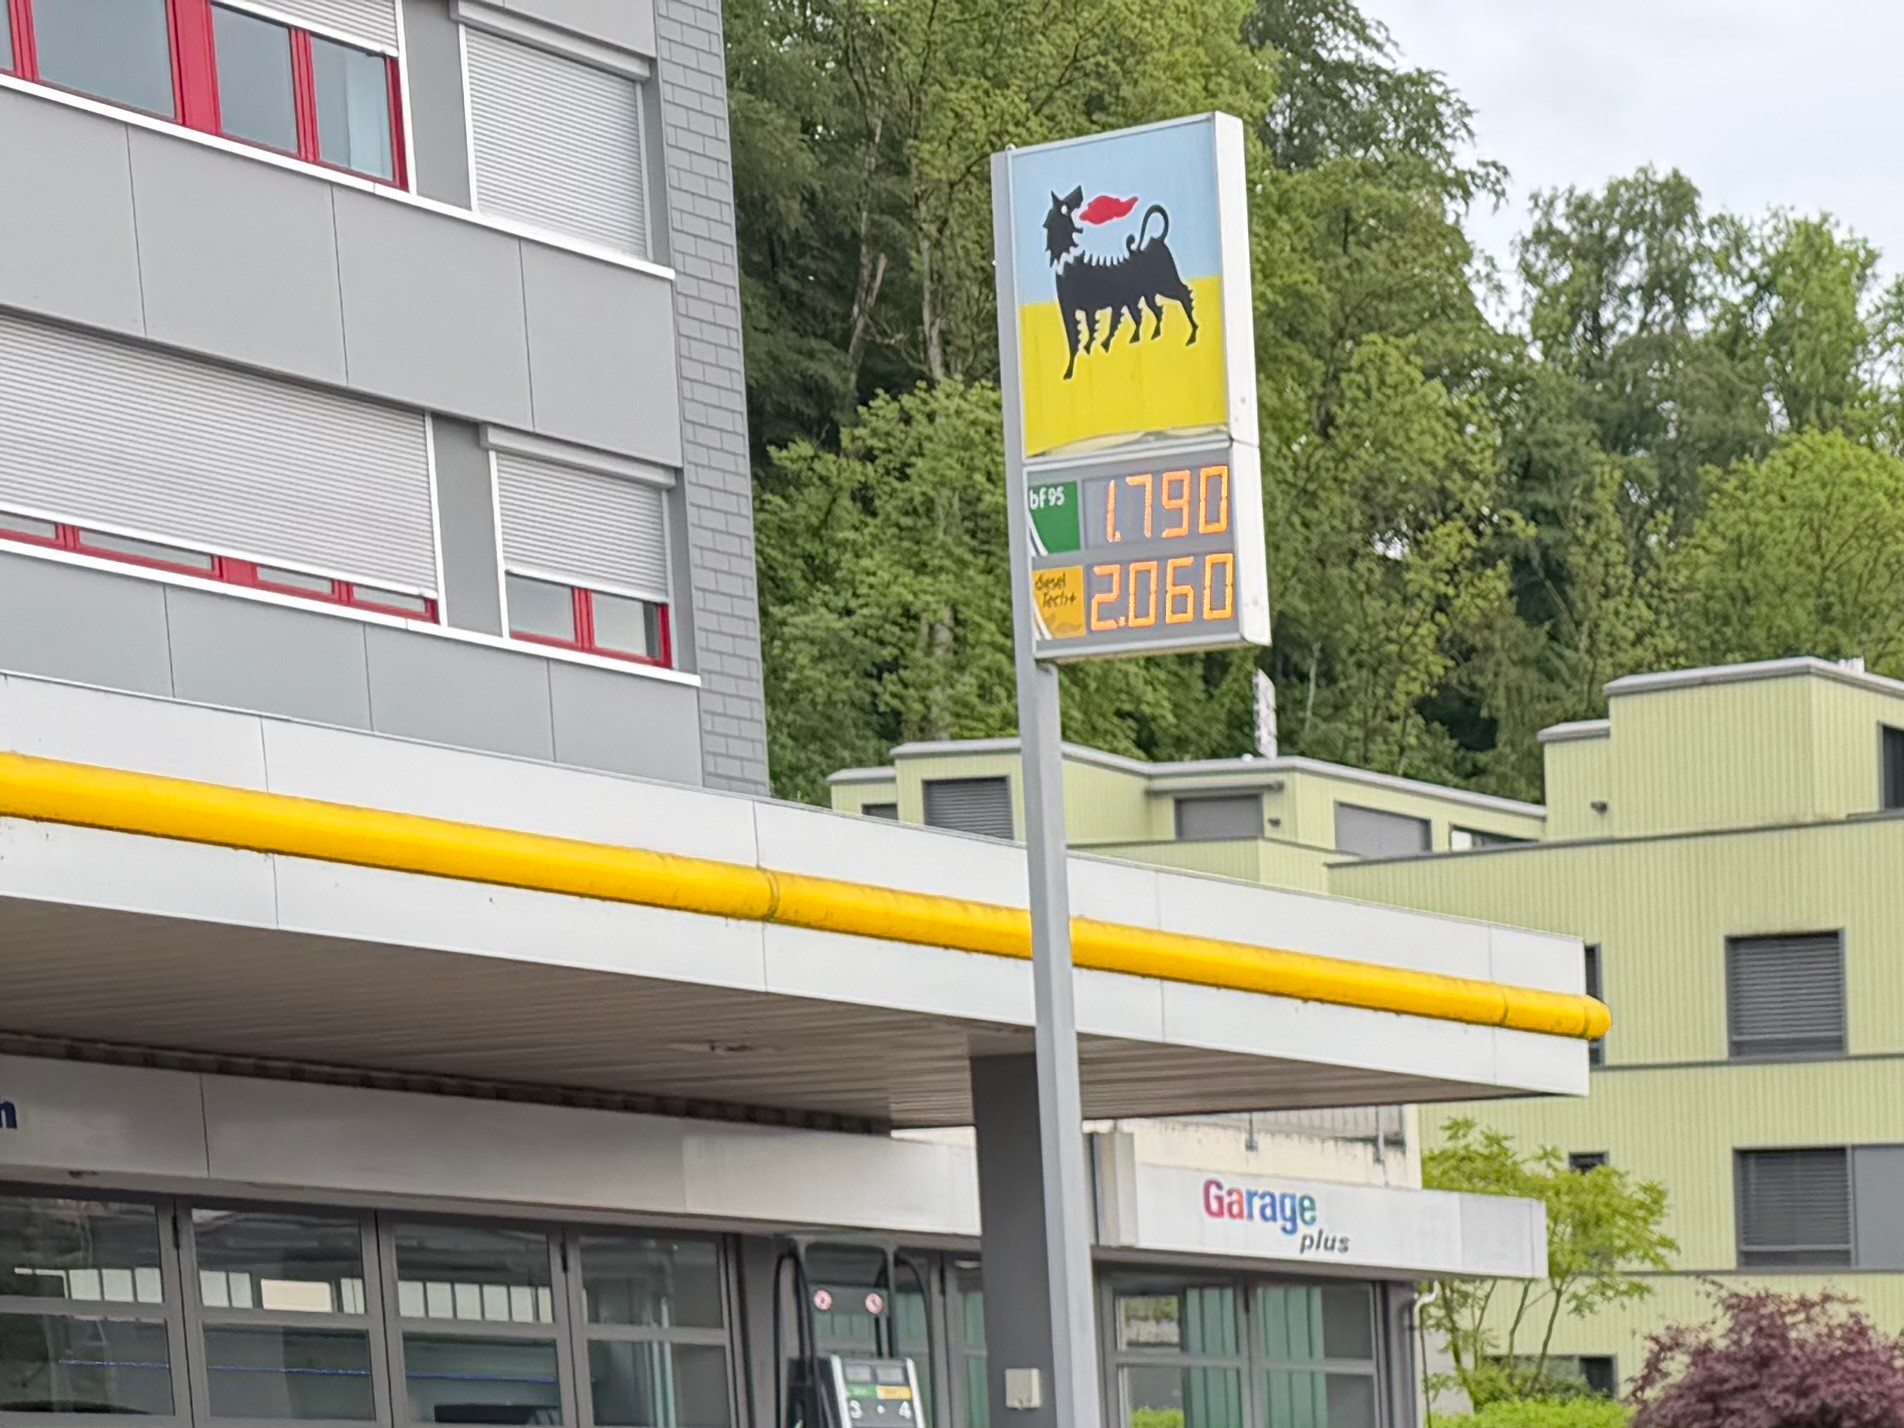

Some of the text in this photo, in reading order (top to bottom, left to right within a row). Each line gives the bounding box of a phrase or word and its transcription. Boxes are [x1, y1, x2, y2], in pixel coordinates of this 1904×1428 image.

[1091, 554, 1233, 631] 2.060
[1202, 1177, 1317, 1236] Garage
[1299, 1226, 1350, 1254] plus
[849, 1400, 863, 1419] 3
[898, 1400, 913, 1420] 4
